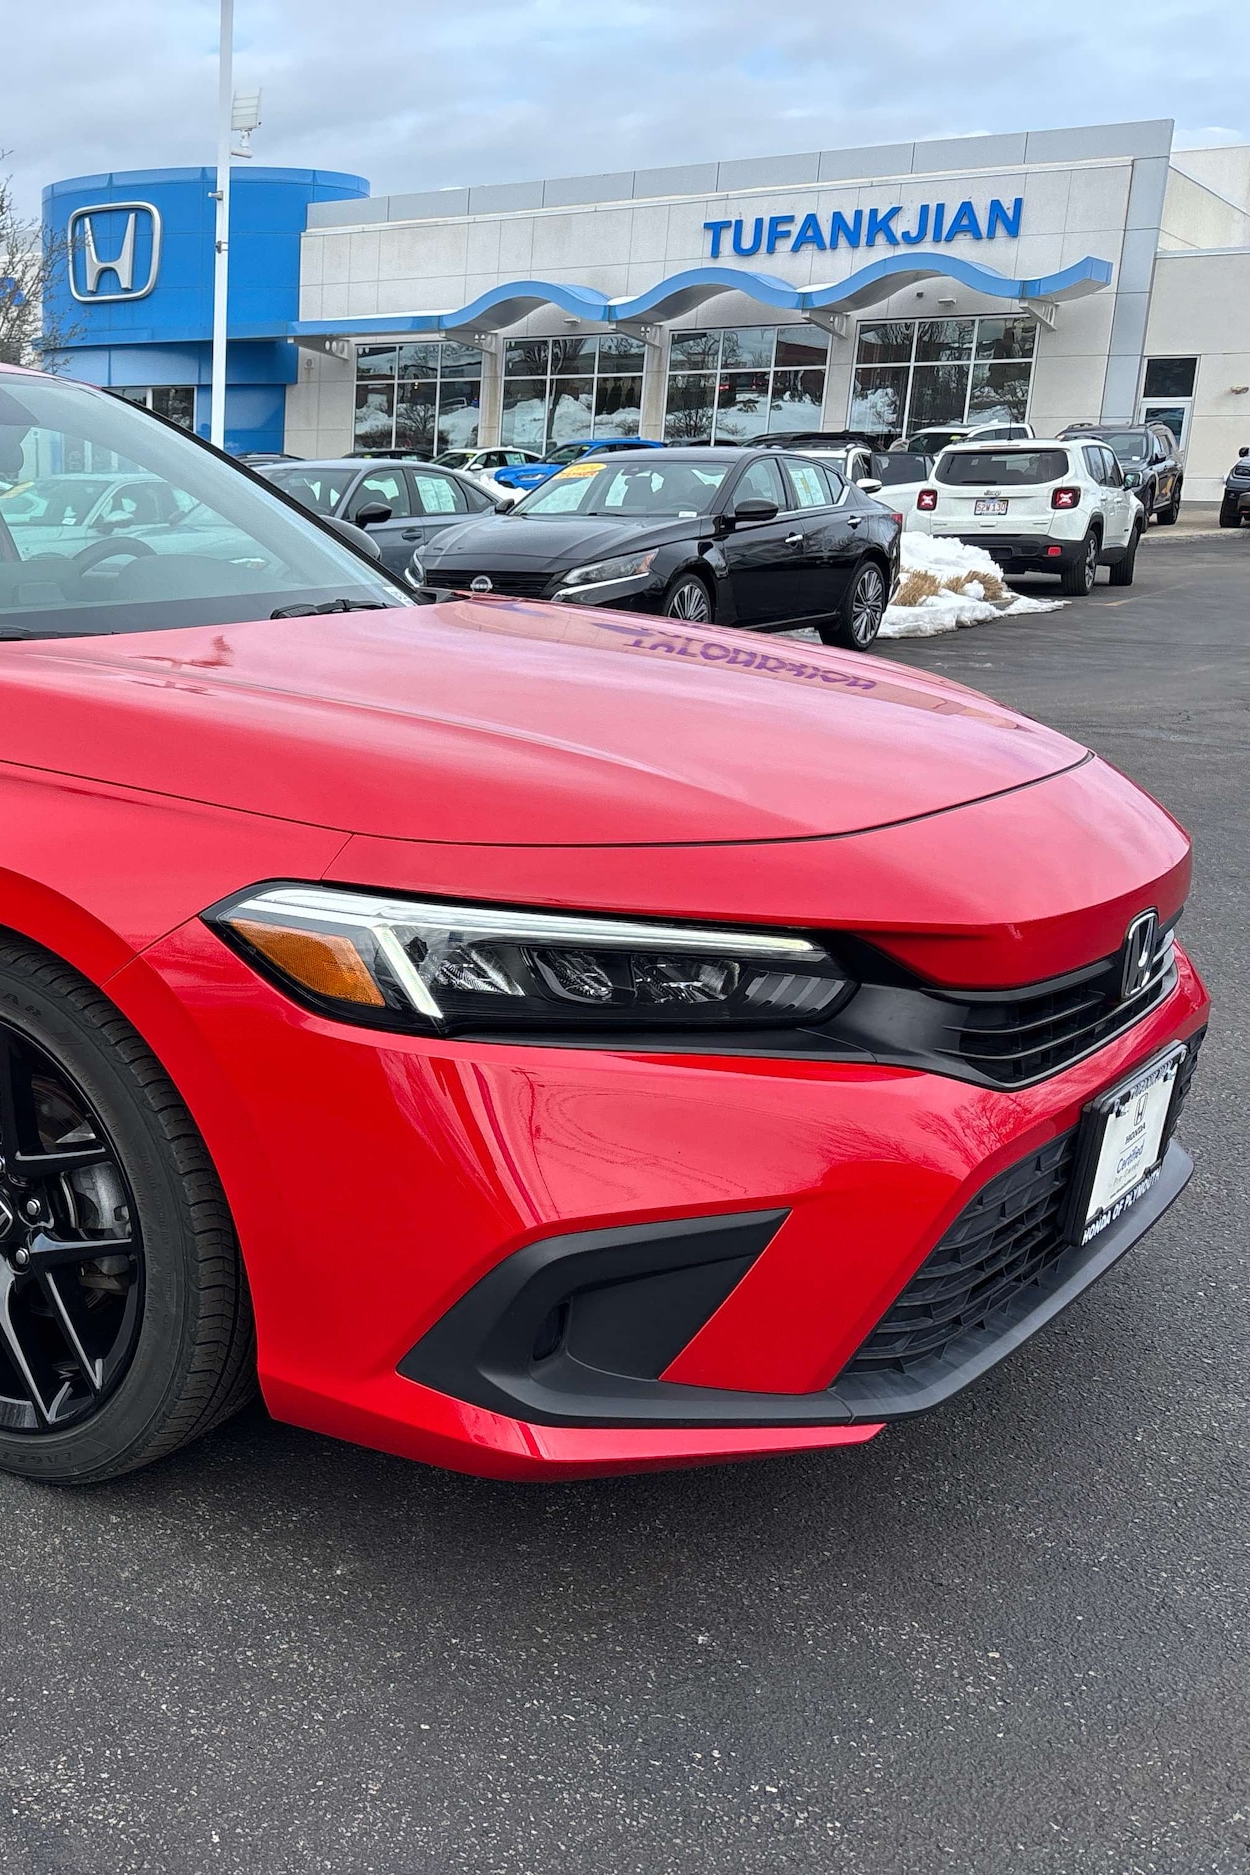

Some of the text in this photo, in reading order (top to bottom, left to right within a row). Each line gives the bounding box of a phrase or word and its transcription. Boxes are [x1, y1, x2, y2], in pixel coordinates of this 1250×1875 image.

[703, 197, 1023, 259] TUFANKJIAN
[1081, 1210, 1111, 1246] HONDA
[1112, 1199, 1125, 1220] OF
